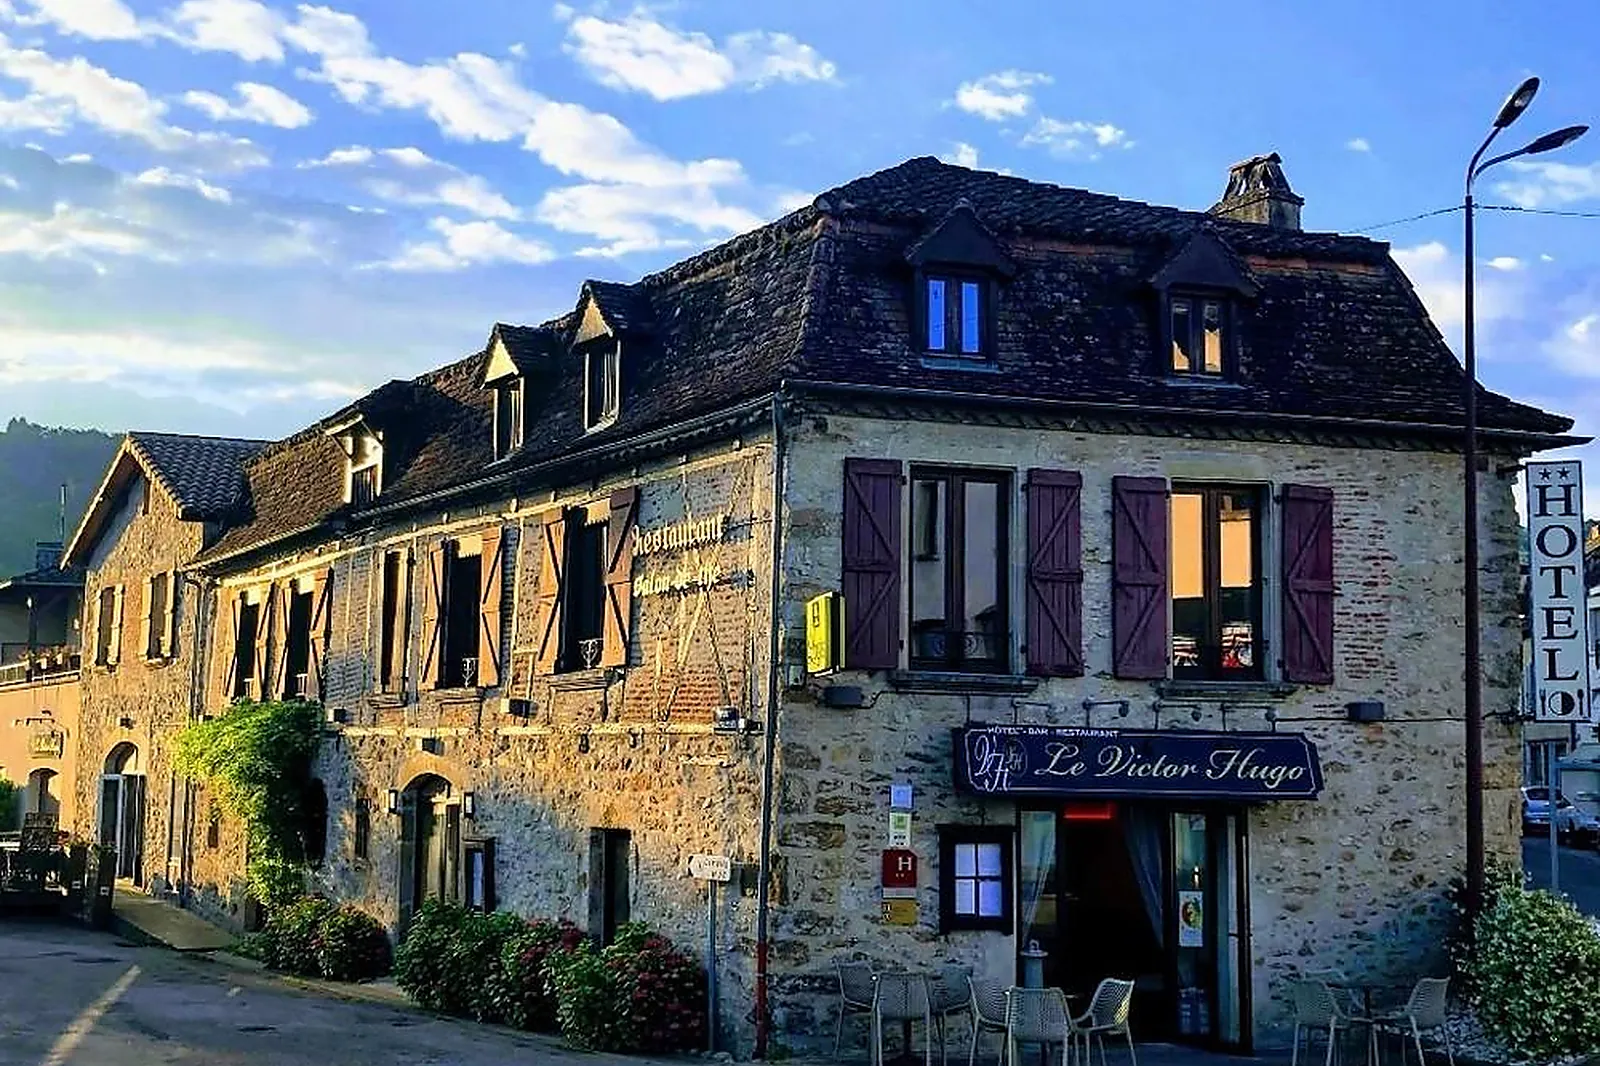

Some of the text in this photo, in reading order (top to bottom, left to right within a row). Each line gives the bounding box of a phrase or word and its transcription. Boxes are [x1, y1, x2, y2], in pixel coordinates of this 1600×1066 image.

[1533, 484, 1579, 681] HOTEL
[1056, 728, 1120, 738] RESTAURANT
[1034, 741, 1307, 790] Le Victor Hugo
[898, 856, 912, 871] H
